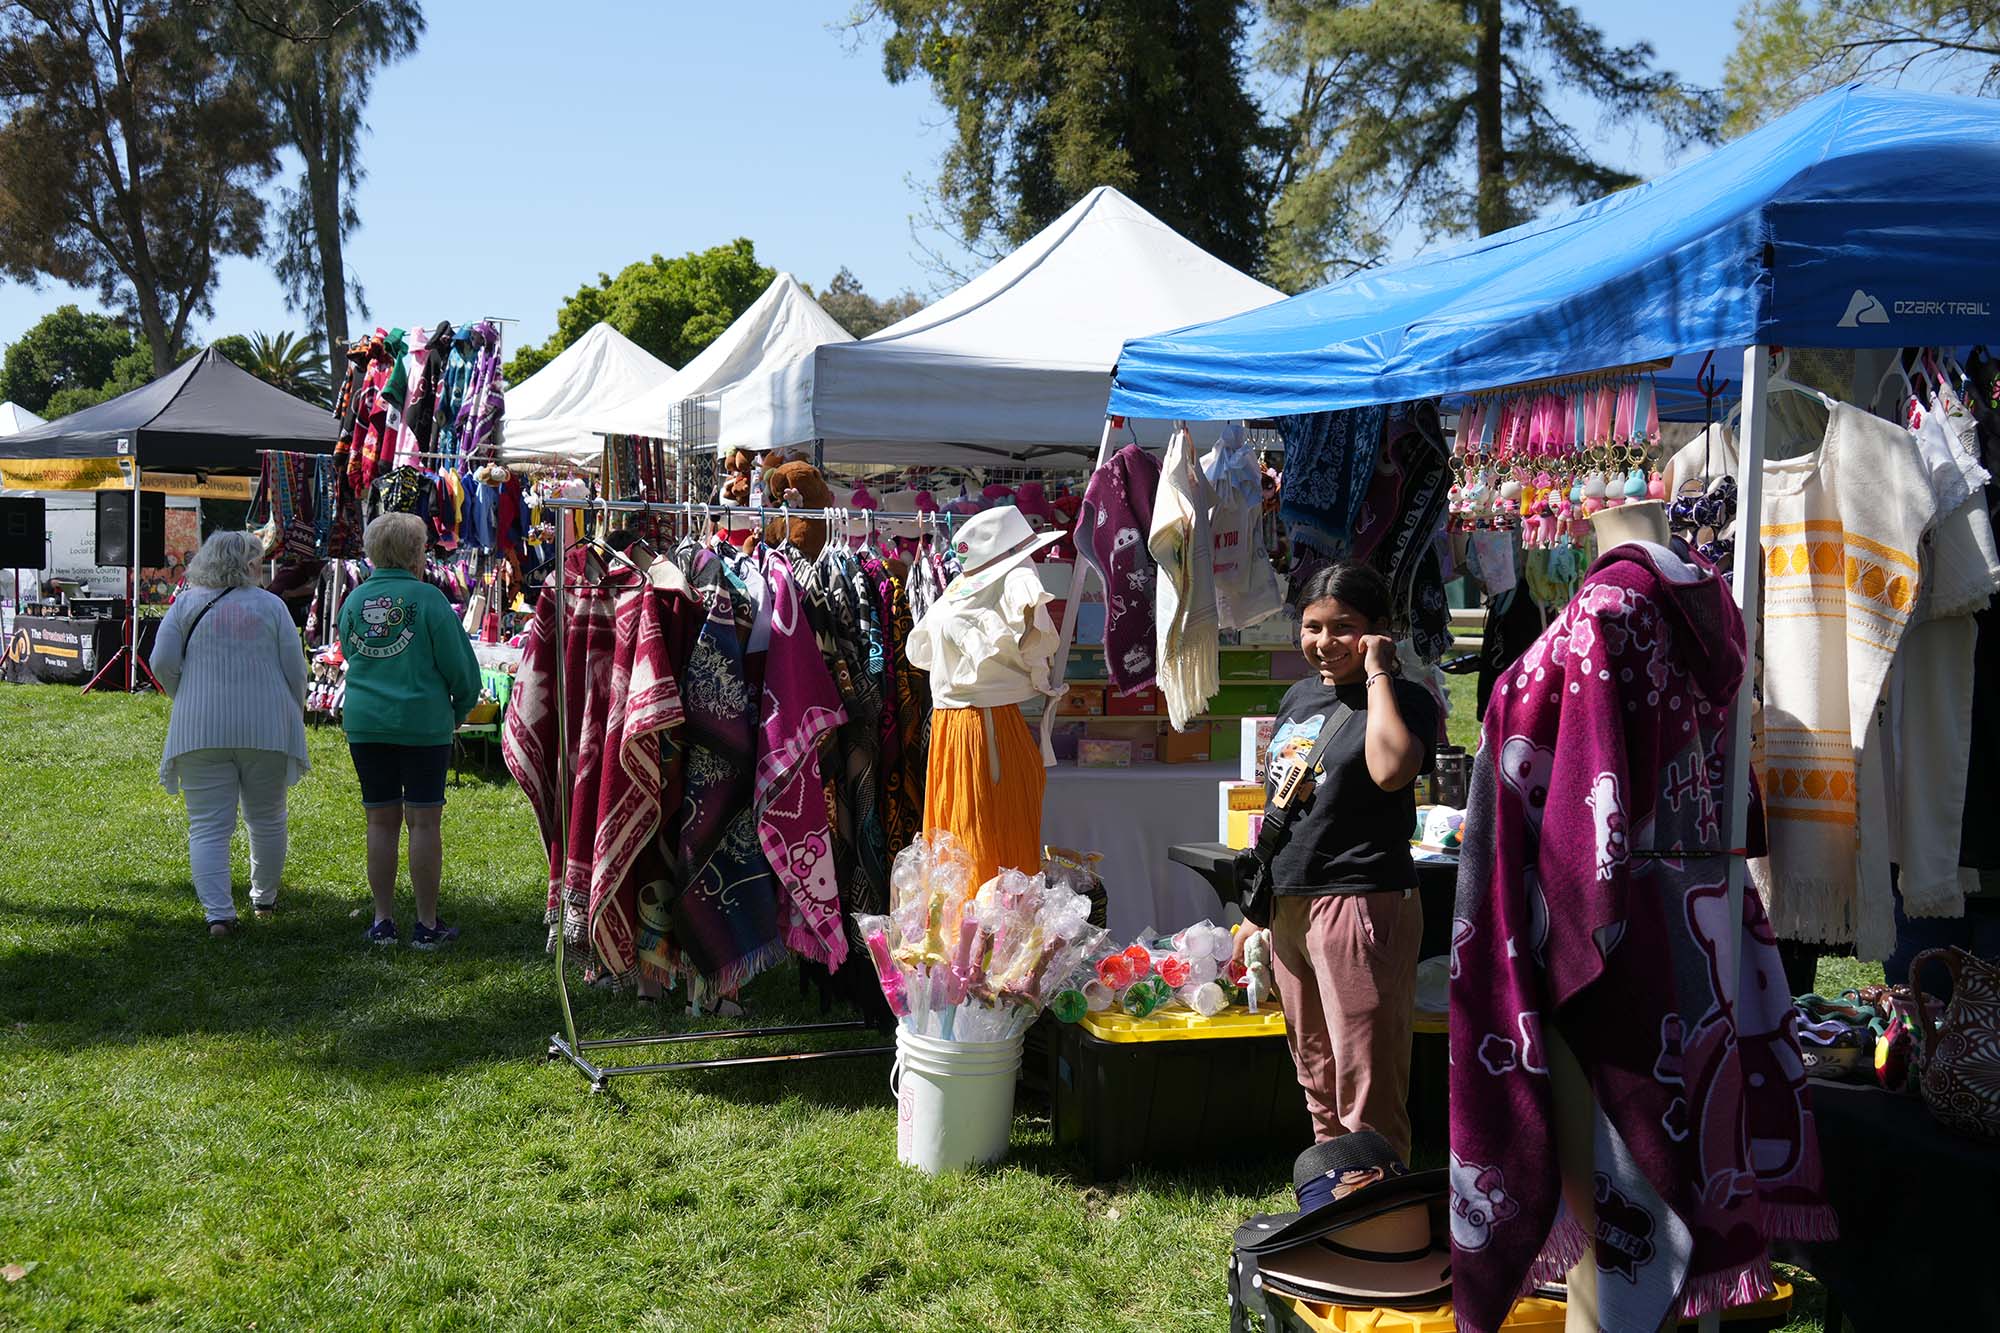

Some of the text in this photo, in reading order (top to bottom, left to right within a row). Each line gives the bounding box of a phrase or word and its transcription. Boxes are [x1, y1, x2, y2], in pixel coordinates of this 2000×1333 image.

[96, 567, 120, 576] County
[31, 628, 41, 639] The
[66, 633, 78, 644] Hits
